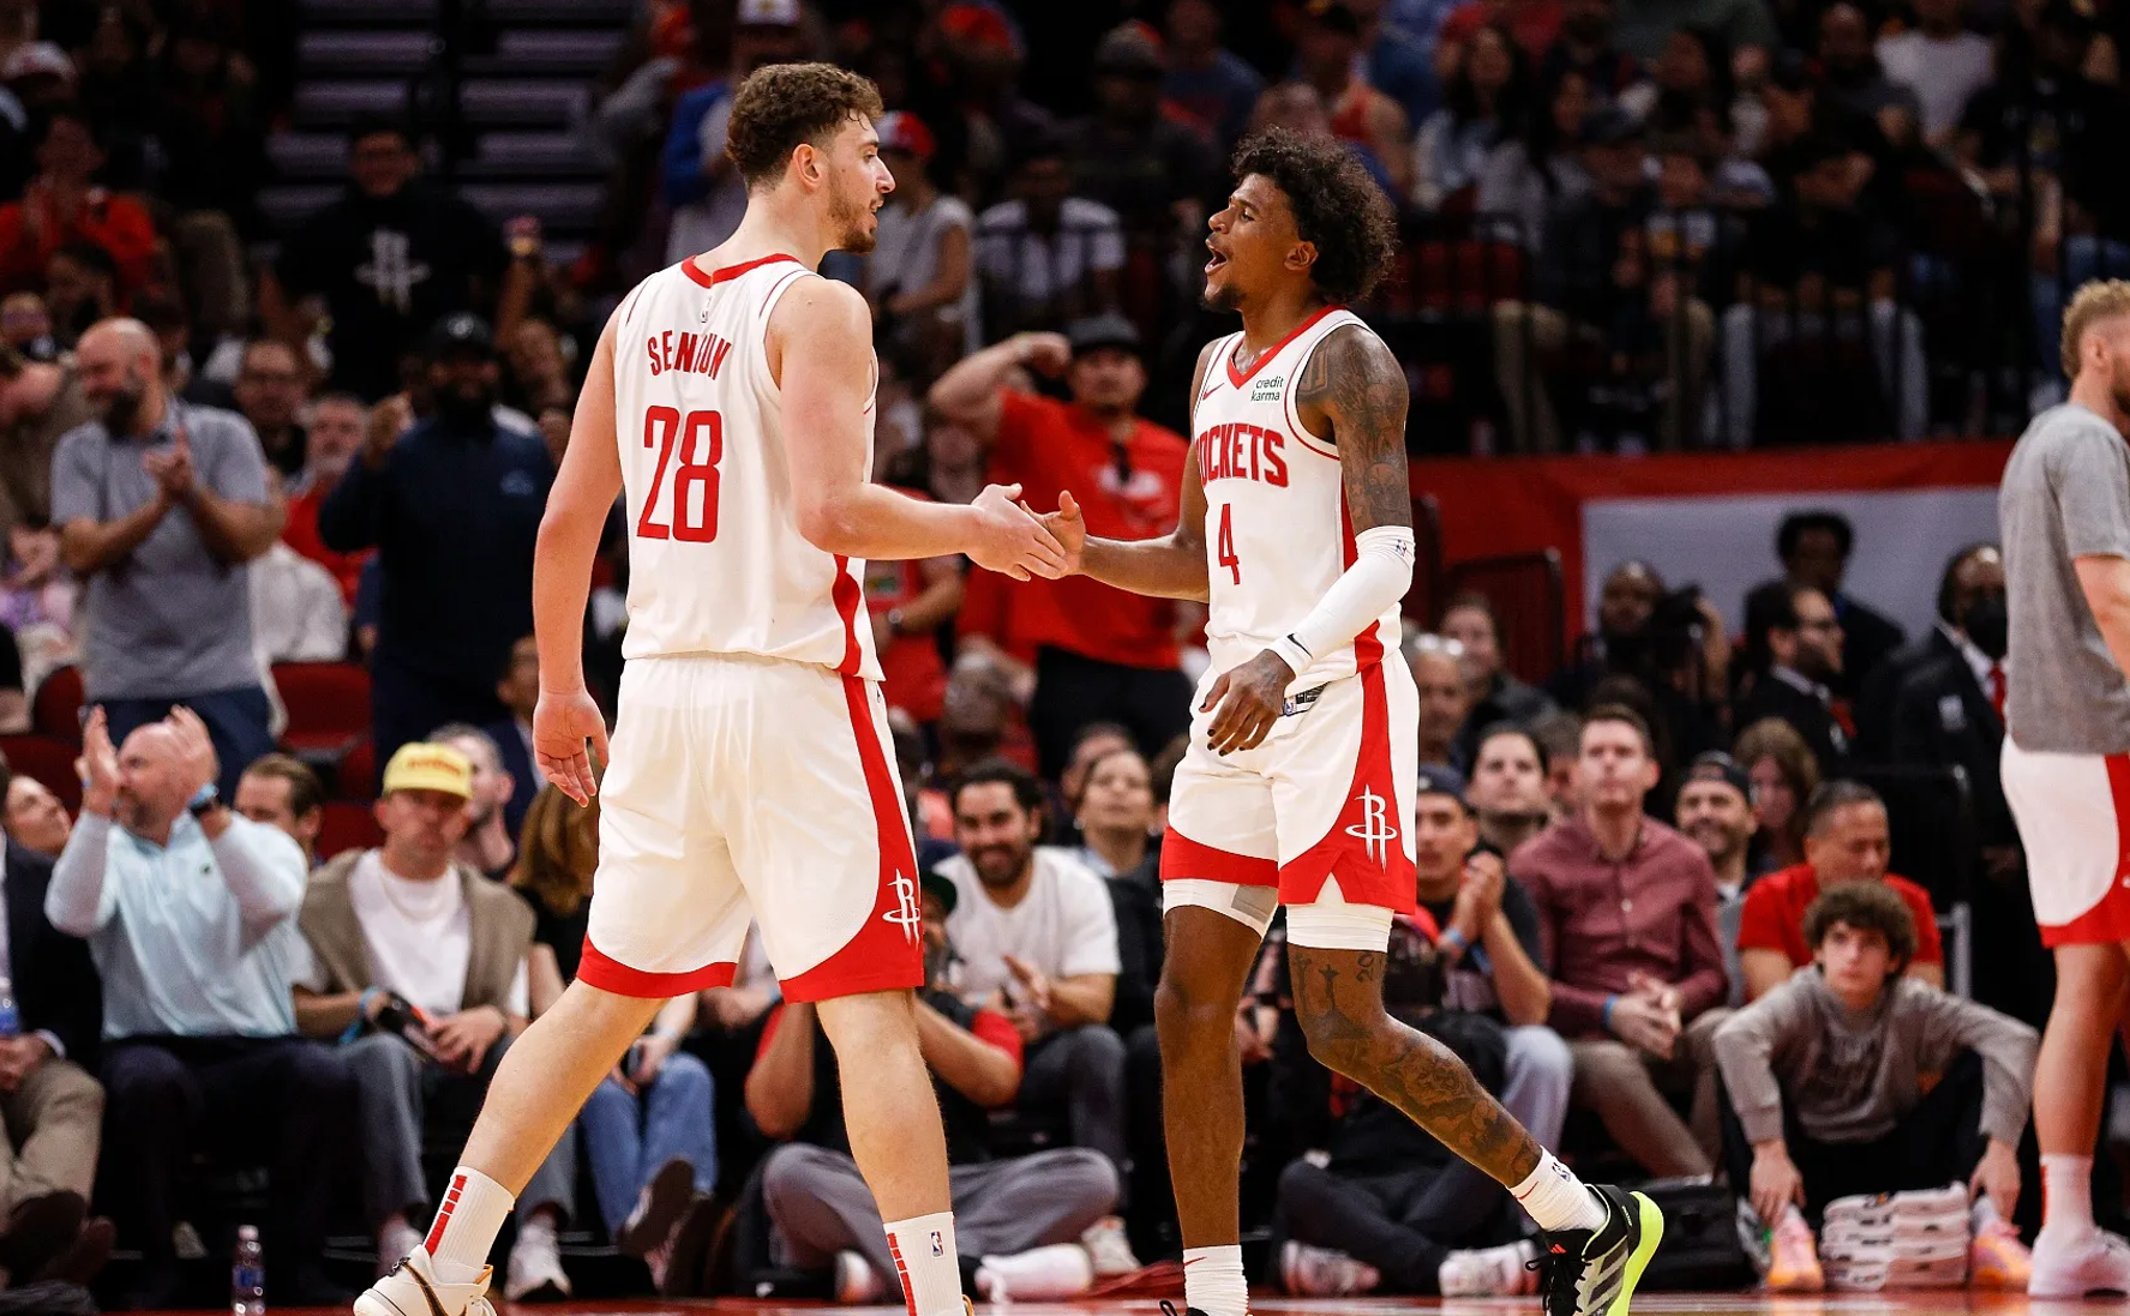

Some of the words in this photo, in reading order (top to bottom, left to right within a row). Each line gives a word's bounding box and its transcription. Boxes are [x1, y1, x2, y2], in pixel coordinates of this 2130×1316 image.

[647, 329, 731, 380] SENUN
[1255, 375, 1284, 389] credit
[1250, 389, 1281, 402] karma
[636, 404, 723, 543] 28
[1195, 423, 1289, 488] OCKETS
[1218, 502, 1241, 586] 4
